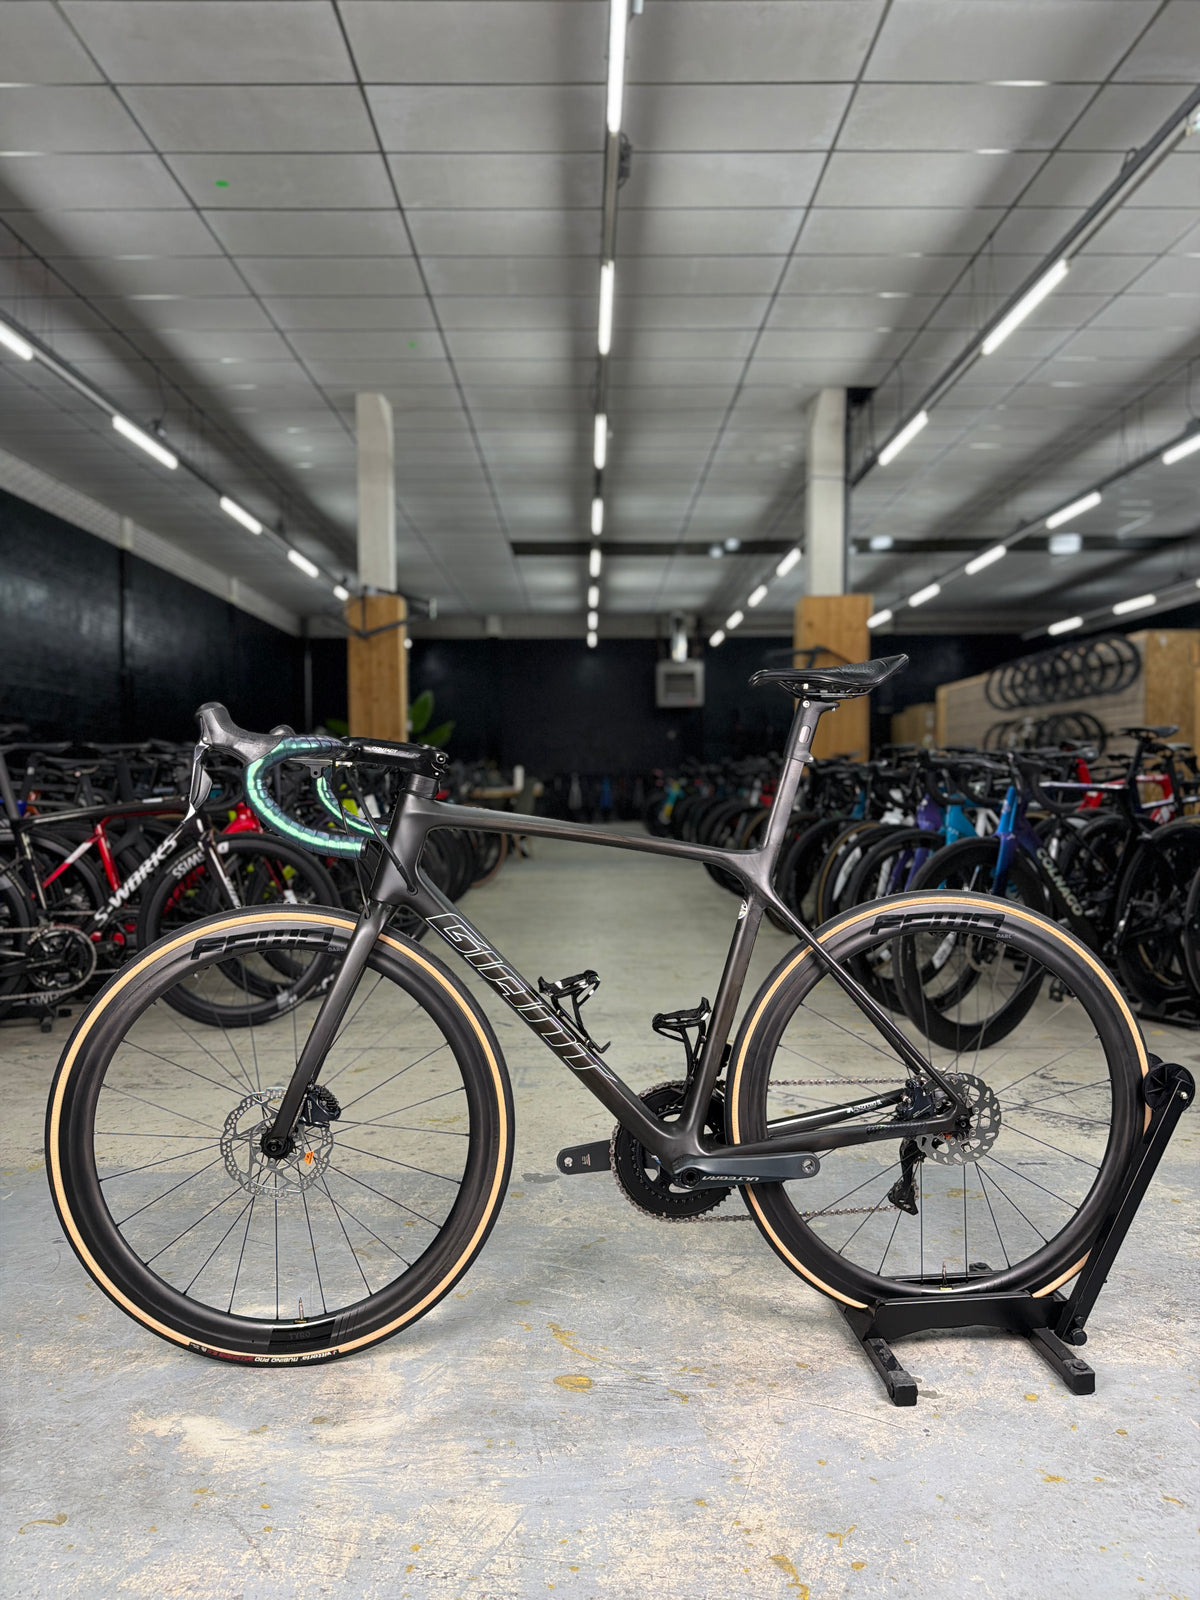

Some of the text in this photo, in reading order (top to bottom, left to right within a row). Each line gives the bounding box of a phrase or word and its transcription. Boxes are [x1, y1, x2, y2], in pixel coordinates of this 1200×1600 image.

[94, 829, 182, 928] S-WORKS
[1036, 847, 1083, 917] COLNAGO
[426, 913, 618, 1082] GIANT
[254, 1356, 270, 1364] PRO
[271, 1356, 299, 1364] RUBINO
